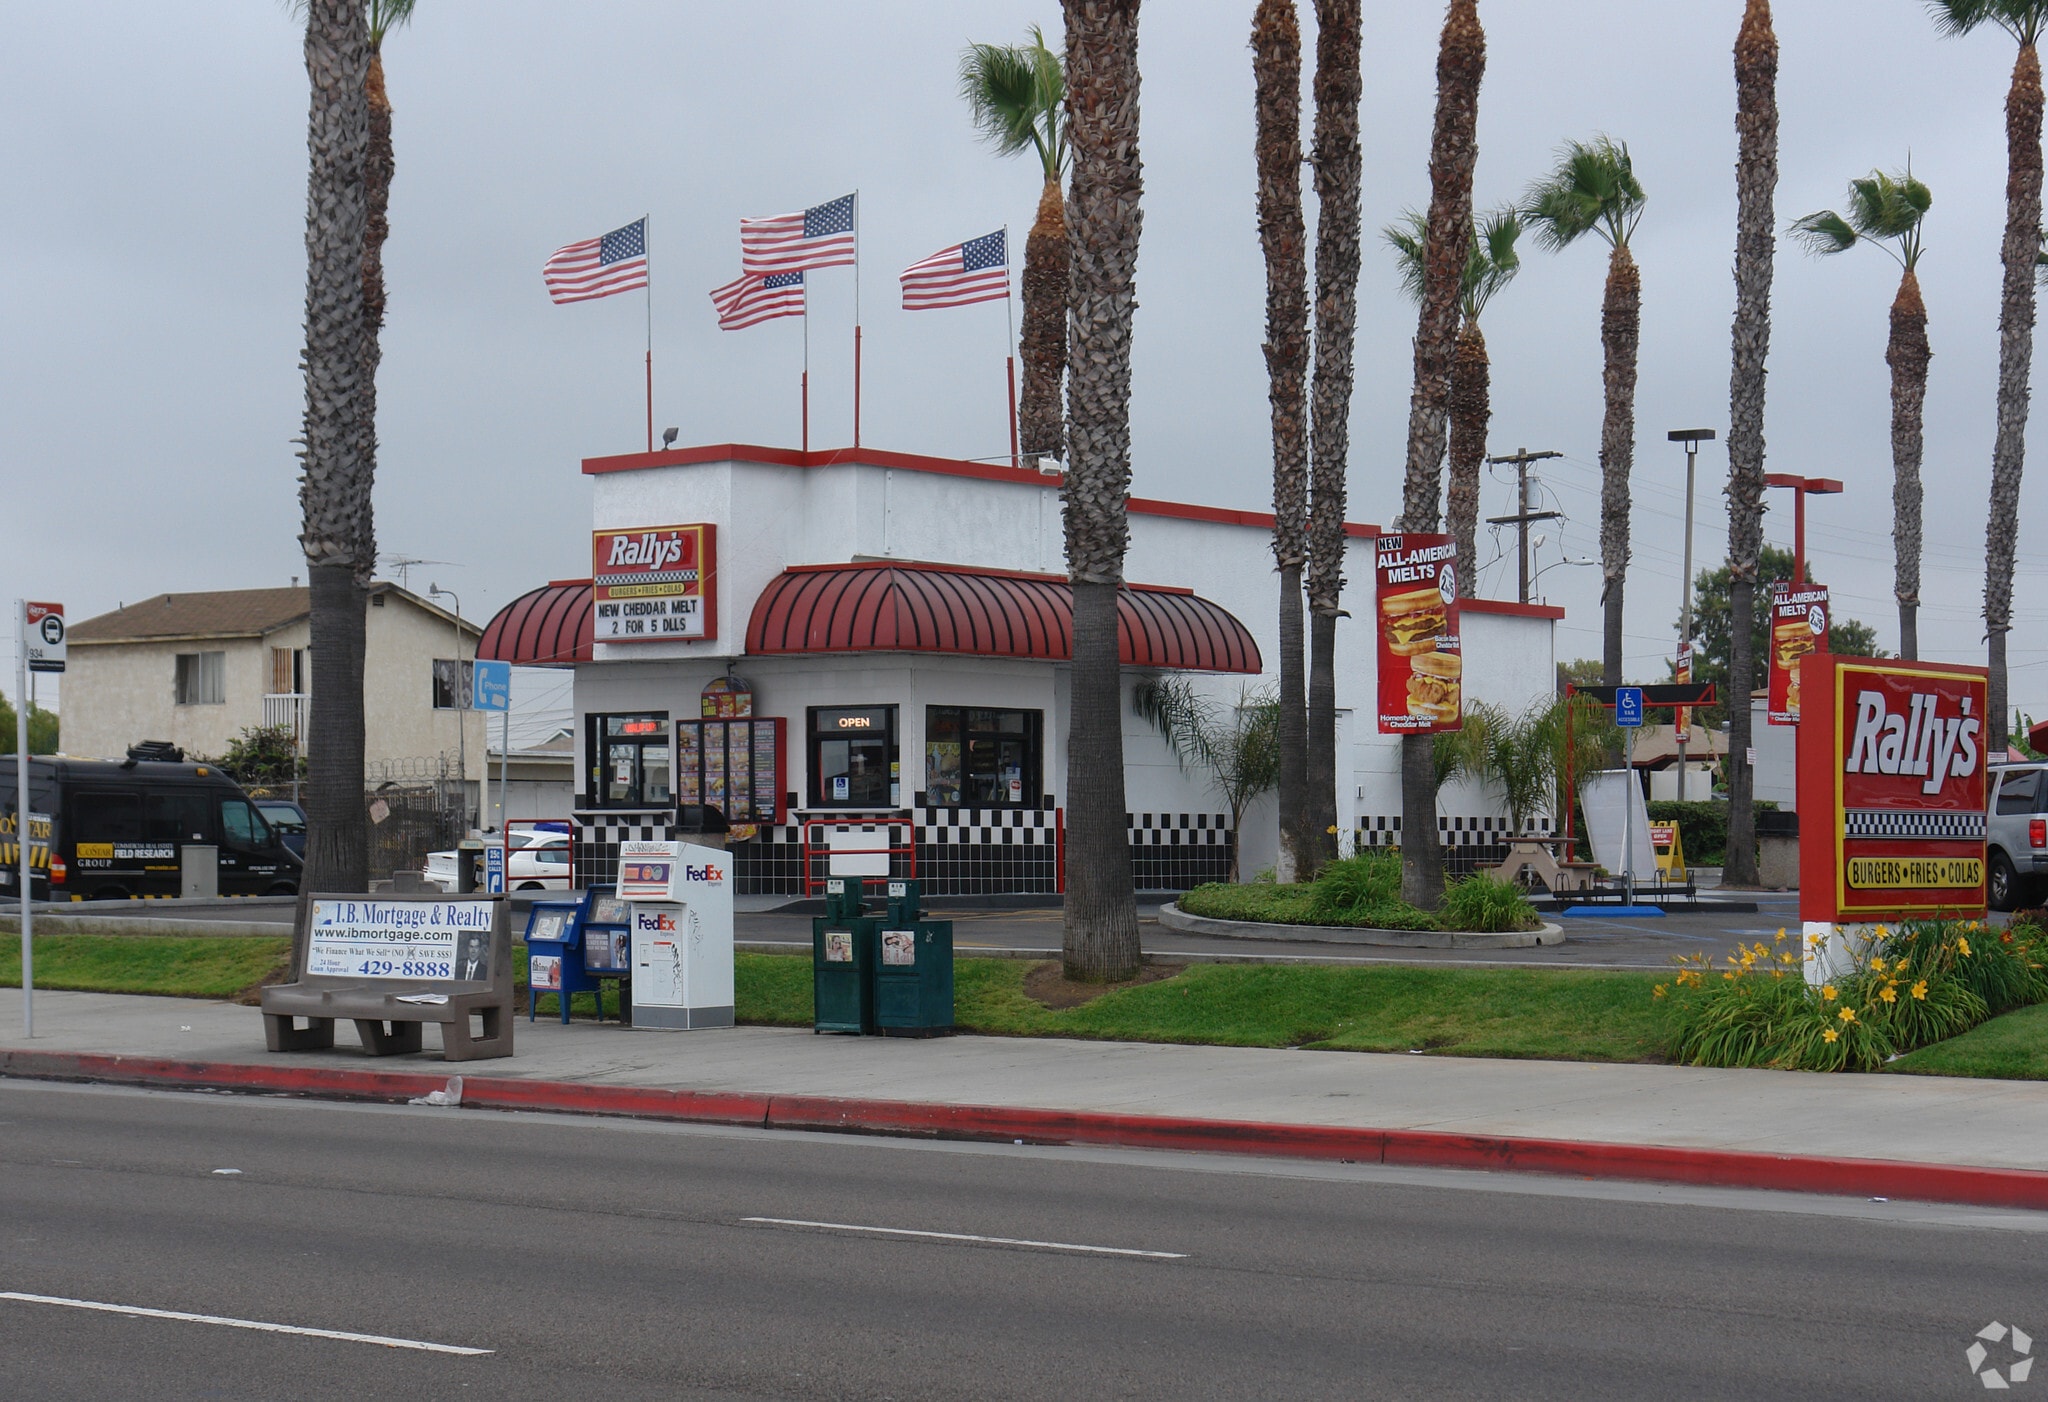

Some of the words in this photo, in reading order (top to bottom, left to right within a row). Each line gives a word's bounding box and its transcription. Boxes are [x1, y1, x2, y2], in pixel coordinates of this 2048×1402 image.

[606, 531, 682, 570] Rally's
[1378, 536, 1402, 551] NEW
[1377, 542, 1457, 568] ALL-AMERICAN
[1388, 563, 1435, 584] MELTS
[610, 586, 637, 596] BURGERS
[642, 584, 659, 595] FRIES
[663, 583, 682, 593] COLAS
[1773, 590, 1827, 606] ALL-AMERICAN
[598, 603, 620, 618] NEW
[623, 601, 667, 616] CHEDDAR
[671, 600, 698, 614] MELT
[1779, 604, 1807, 617] MELTS
[612, 621, 618, 634] 2
[625, 620, 644, 633] FOR
[651, 619, 657, 632] 5
[662, 618, 686, 632] DLLS
[29, 648, 43, 659] 934
[484, 681, 507, 692] Phone
[838, 717, 870, 728] OPEN
[1380, 715, 1415, 724] Homestyle
[1845, 690, 1980, 794] Rally's
[114, 849, 133, 858] FIELD
[134, 849, 174, 858] RESEARCH
[77, 859, 112, 867] GROUP
[686, 864, 723, 881] FedEx
[1853, 861, 1901, 884] BURGERS
[1910, 862, 1938, 883] FRIES
[1948, 862, 1979, 883] COLAS
[336, 903, 359, 923] I.B.
[363, 903, 427, 929] Mortgage
[430, 904, 442, 925] &
[446, 905, 492, 931] Realty
[638, 913, 676, 930] FedEx
[314, 927, 453, 942] www.ibmortgage.com
[325, 947, 347, 955] Finance
[349, 947, 364, 956] What
[366, 948, 375, 956] We
[326, 965, 349, 973] Approval
[358, 960, 450, 977] 429-8888
